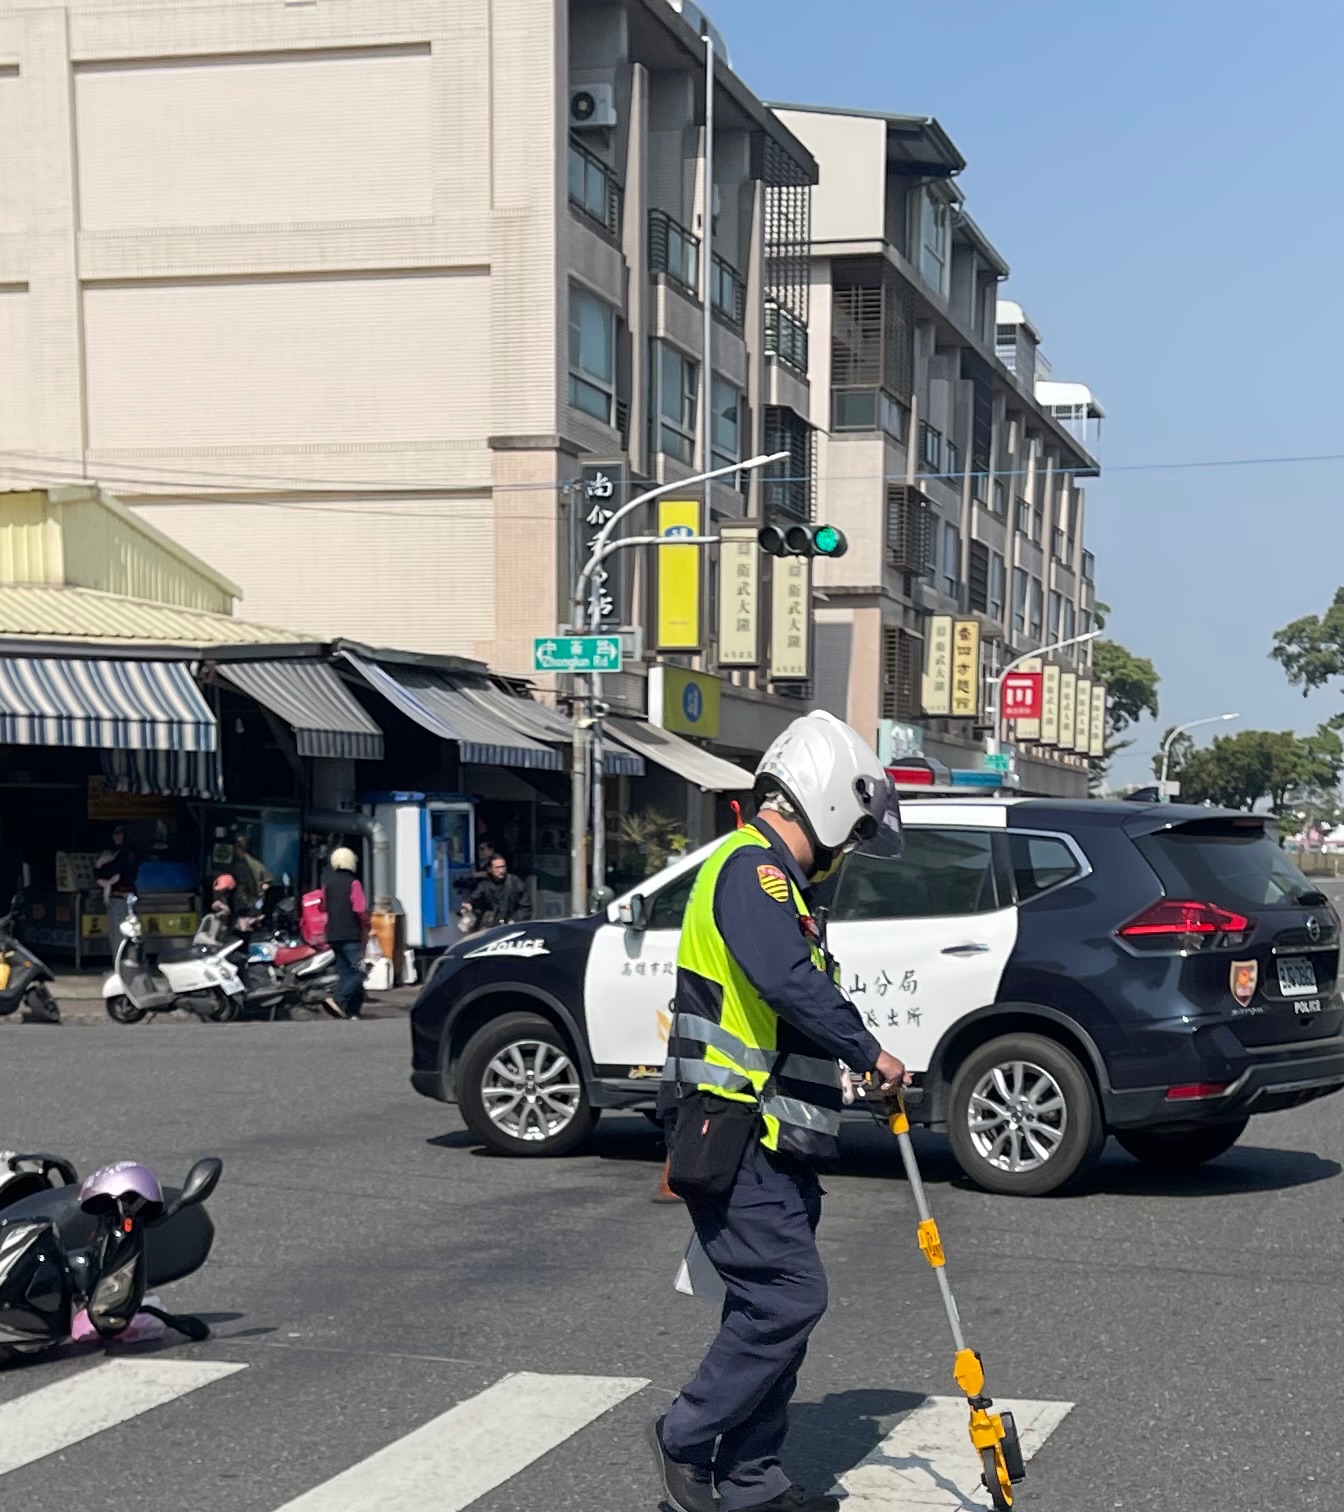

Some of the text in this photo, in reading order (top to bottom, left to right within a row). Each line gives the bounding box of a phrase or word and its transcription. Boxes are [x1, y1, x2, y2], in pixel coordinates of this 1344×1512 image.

[487, 939, 545, 952] POLICE
[620, 961, 674, 976] 高雄市政
[849, 969, 918, 996] 山分局
[1293, 999, 1322, 1015] POLICE
